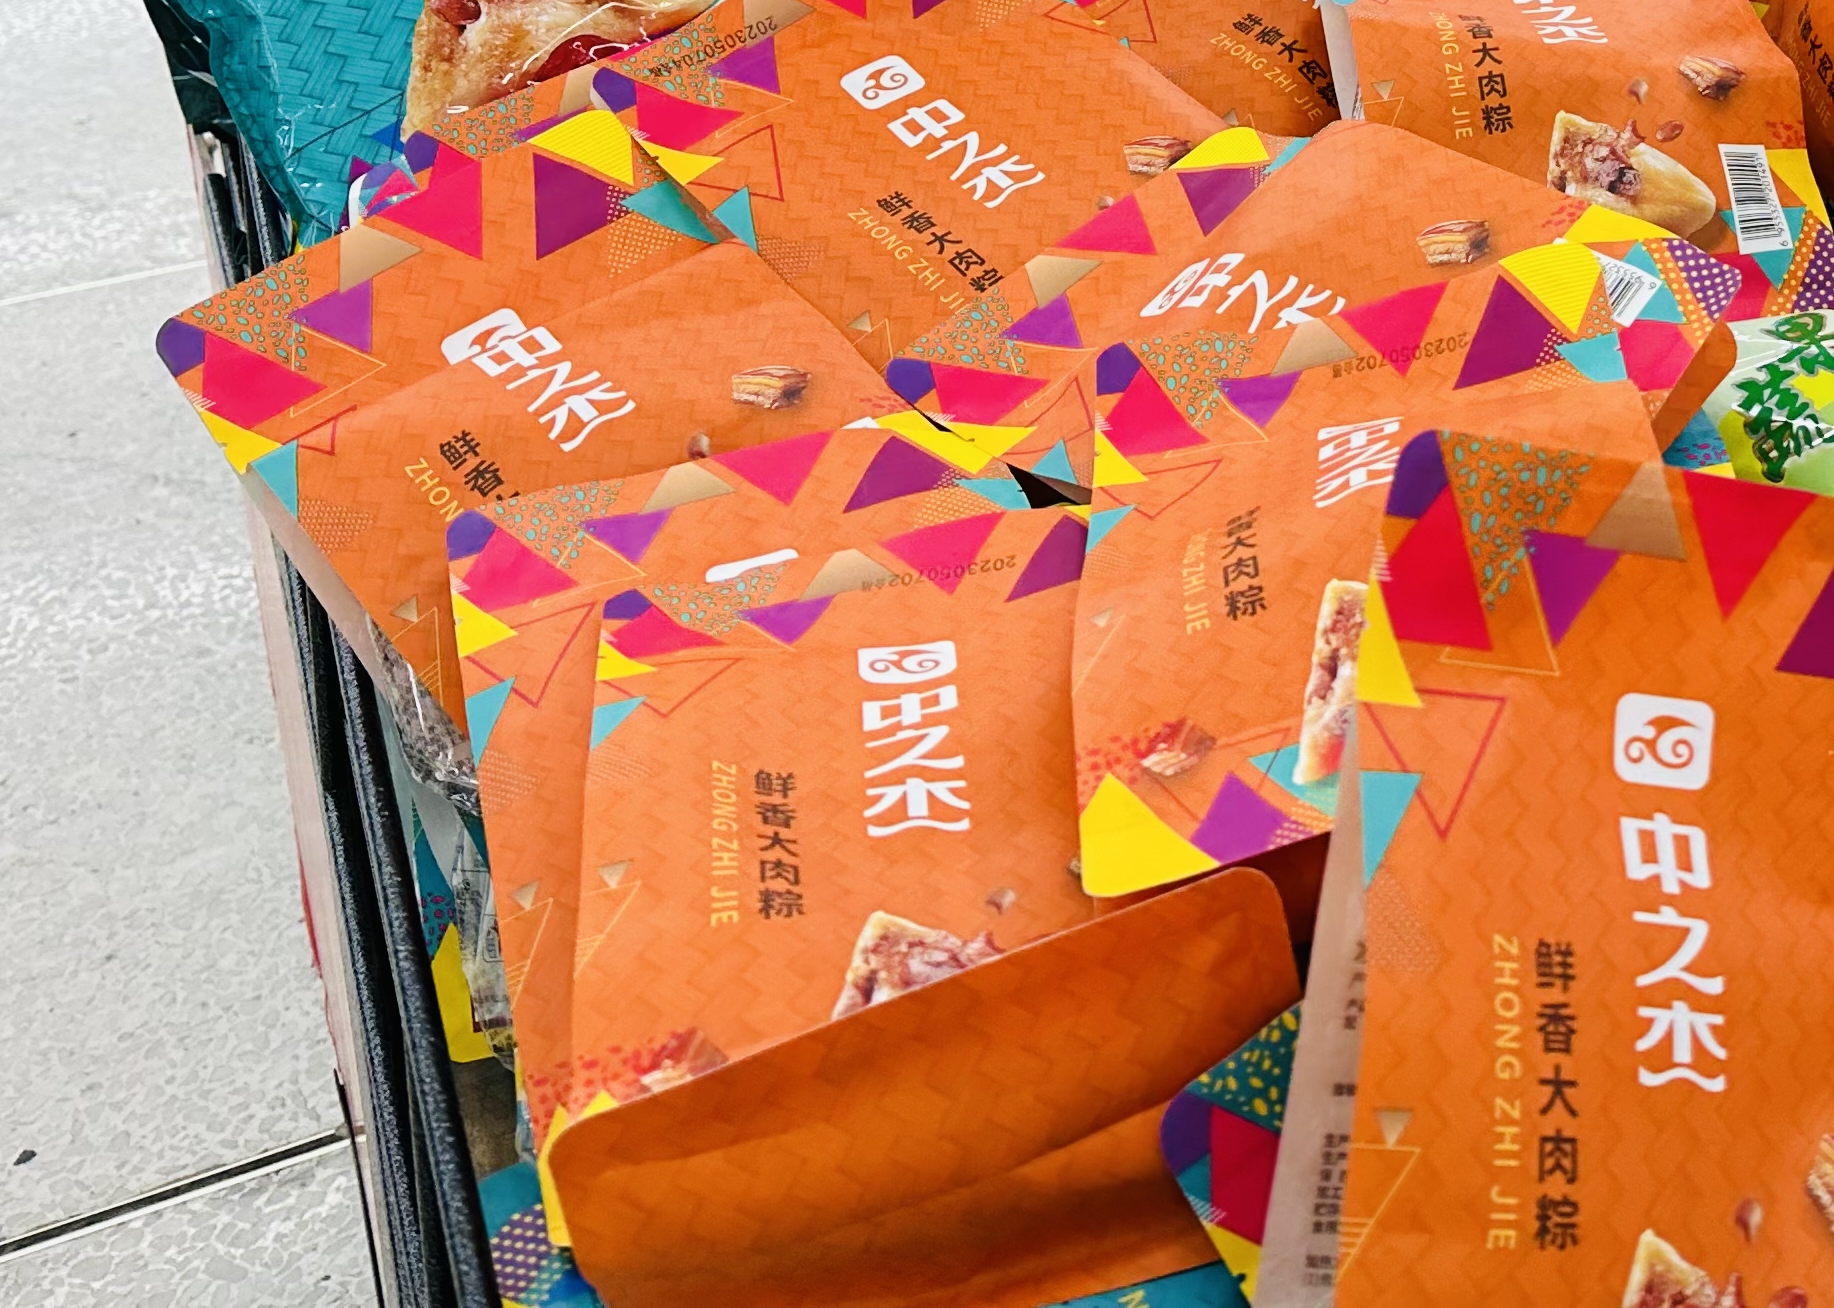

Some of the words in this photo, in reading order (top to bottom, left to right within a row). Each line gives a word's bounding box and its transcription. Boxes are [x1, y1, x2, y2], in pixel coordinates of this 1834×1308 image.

[1428, 9, 1462, 56] ZHONG
[1209, 31, 1263, 69] ZHONG
[1261, 62, 1297, 97] ZHI
[1293, 91, 1324, 122] JIE
[1445, 61, 1465, 100] ZHI
[1457, 12, 1514, 138] 鲜香大肉粽
[887, 97, 1047, 211] 中之杰
[1451, 104, 1474, 141] JIE
[847, 206, 913, 262] ZHONG
[906, 257, 946, 292] ZHI
[474, 323, 638, 455] 中之杰
[438, 429, 520, 504] 鲜香
[1183, 602, 1211, 636] JIE
[710, 759, 740, 833] ZHONG
[861, 683, 971, 840] 中之杰
[710, 836, 740, 883] ZHI
[752, 767, 807, 921] 鲜香大肉粽
[710, 886, 740, 927] JIE
[1618, 811, 1727, 1093] 中之杰
[1490, 932, 1522, 1082] ZHONG
[1489, 1097, 1522, 1169] ZHI
[1533, 937, 1581, 1252] 鲜香大肉粽
[1486, 1188, 1518, 1251] JIE
